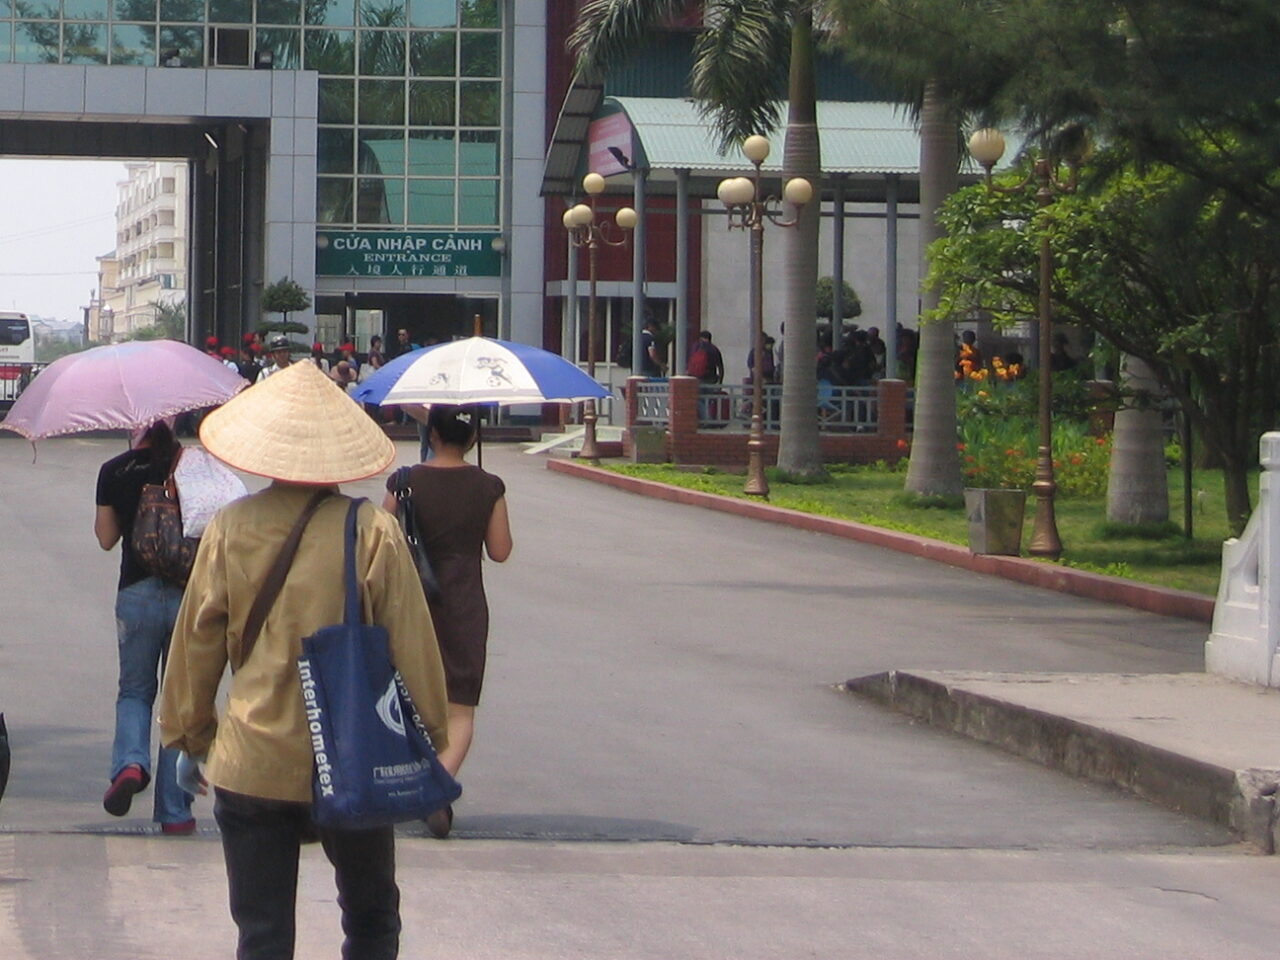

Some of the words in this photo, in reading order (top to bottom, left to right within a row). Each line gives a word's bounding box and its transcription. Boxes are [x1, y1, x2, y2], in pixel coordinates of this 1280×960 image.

[333, 234, 372, 251] CỬA
[377, 235, 426, 254] NHẬP
[432, 234, 483, 252] CẢNH
[363, 253, 452, 263] ENTRANCE
[297, 658, 334, 798] Interhometex
